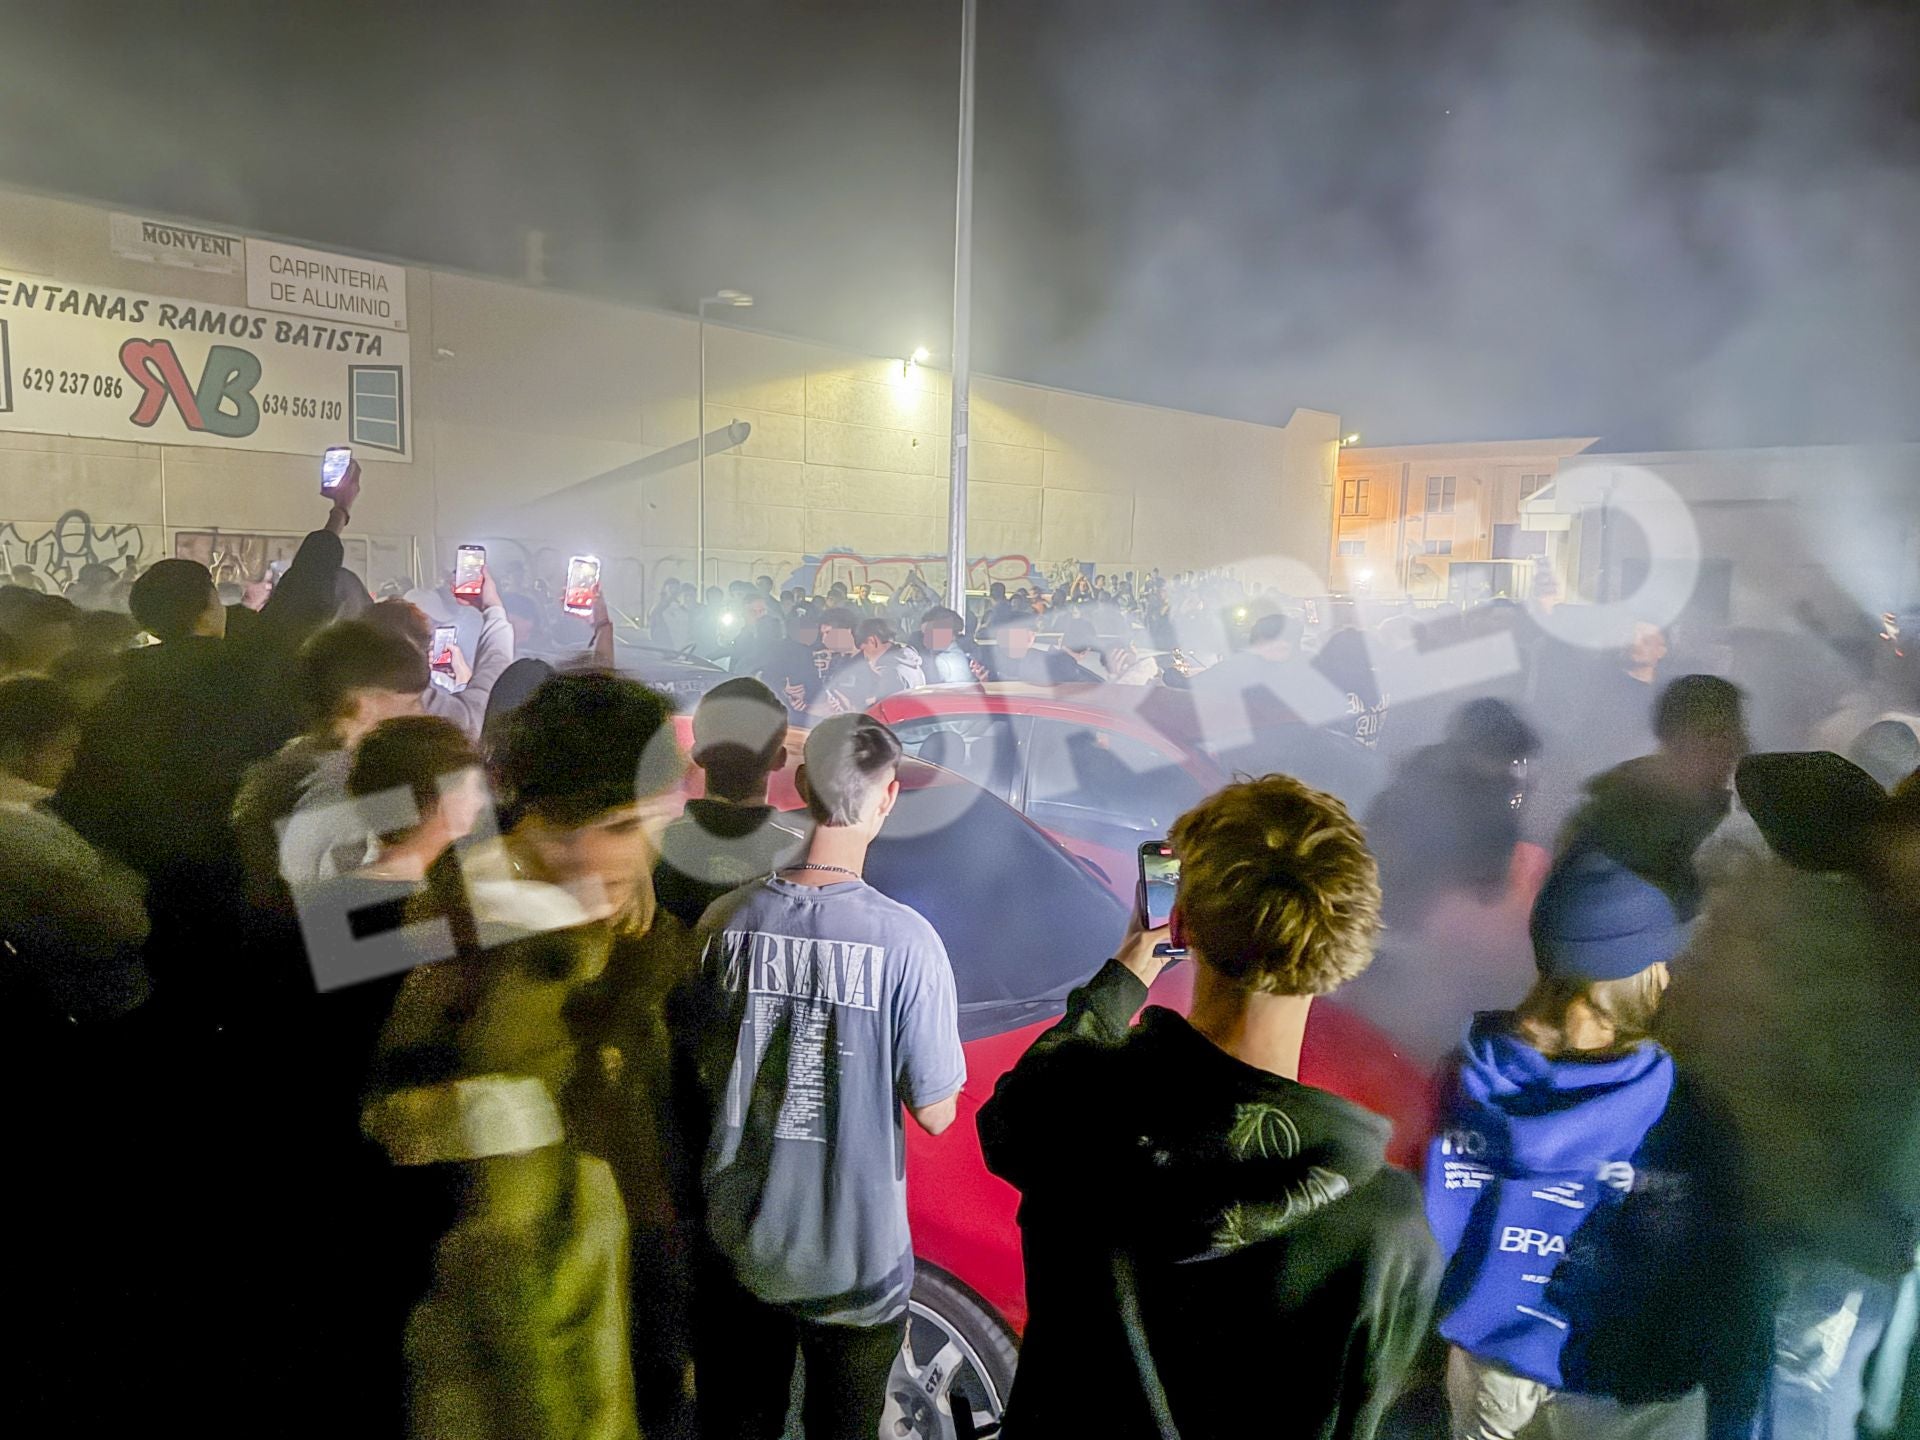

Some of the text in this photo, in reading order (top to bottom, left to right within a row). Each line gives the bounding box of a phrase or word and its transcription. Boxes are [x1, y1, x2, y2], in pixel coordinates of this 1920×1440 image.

[269, 255, 389, 293] CARPINTERIA
[271, 282, 390, 318] DE ALUMINIO
[158, 303, 267, 340] RAMOS
[274, 320, 382, 357] BATISTA
[23, 367, 123, 399] 629 237 086
[262, 393, 342, 421] 634 563 130
